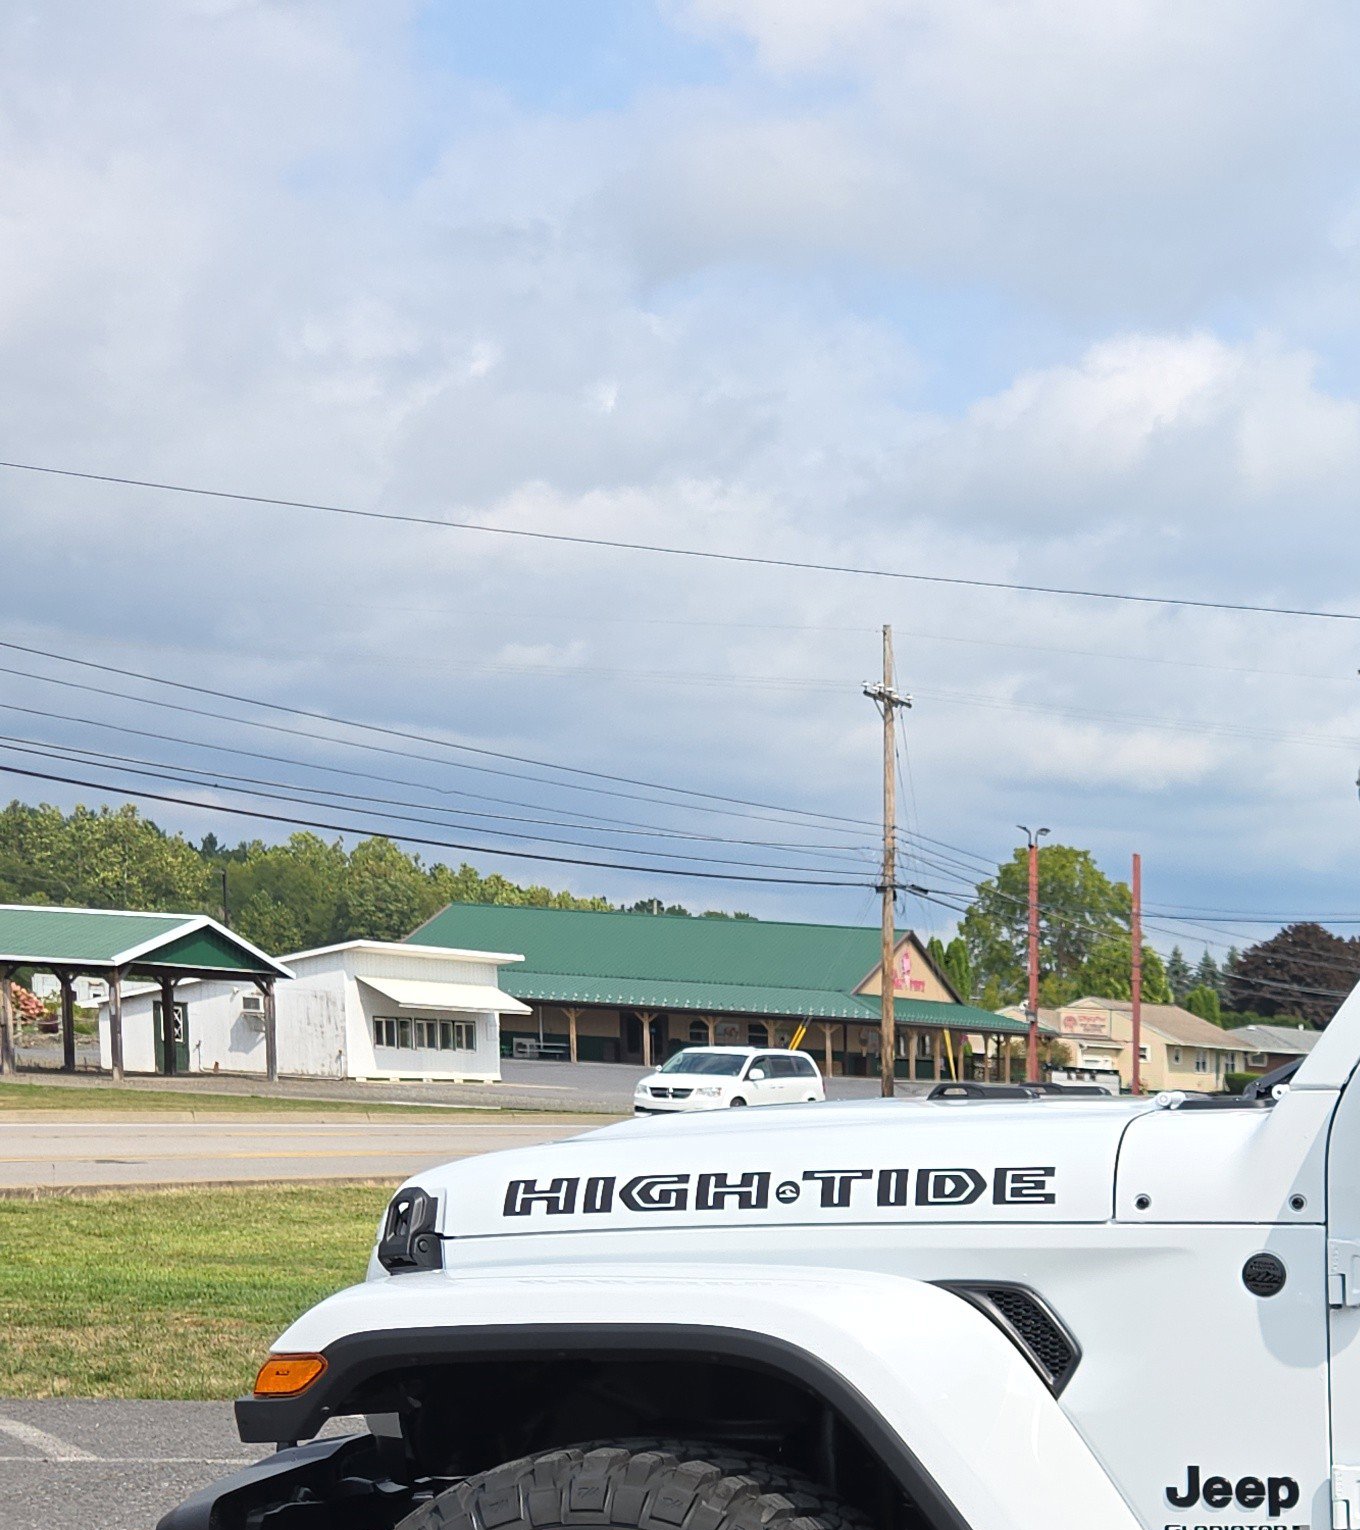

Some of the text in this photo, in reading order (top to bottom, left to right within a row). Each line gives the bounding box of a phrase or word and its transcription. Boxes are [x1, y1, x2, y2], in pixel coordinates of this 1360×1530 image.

[502, 1166, 1057, 1217] HIGH TIDE
[1165, 1465, 1300, 1517] Jeep
